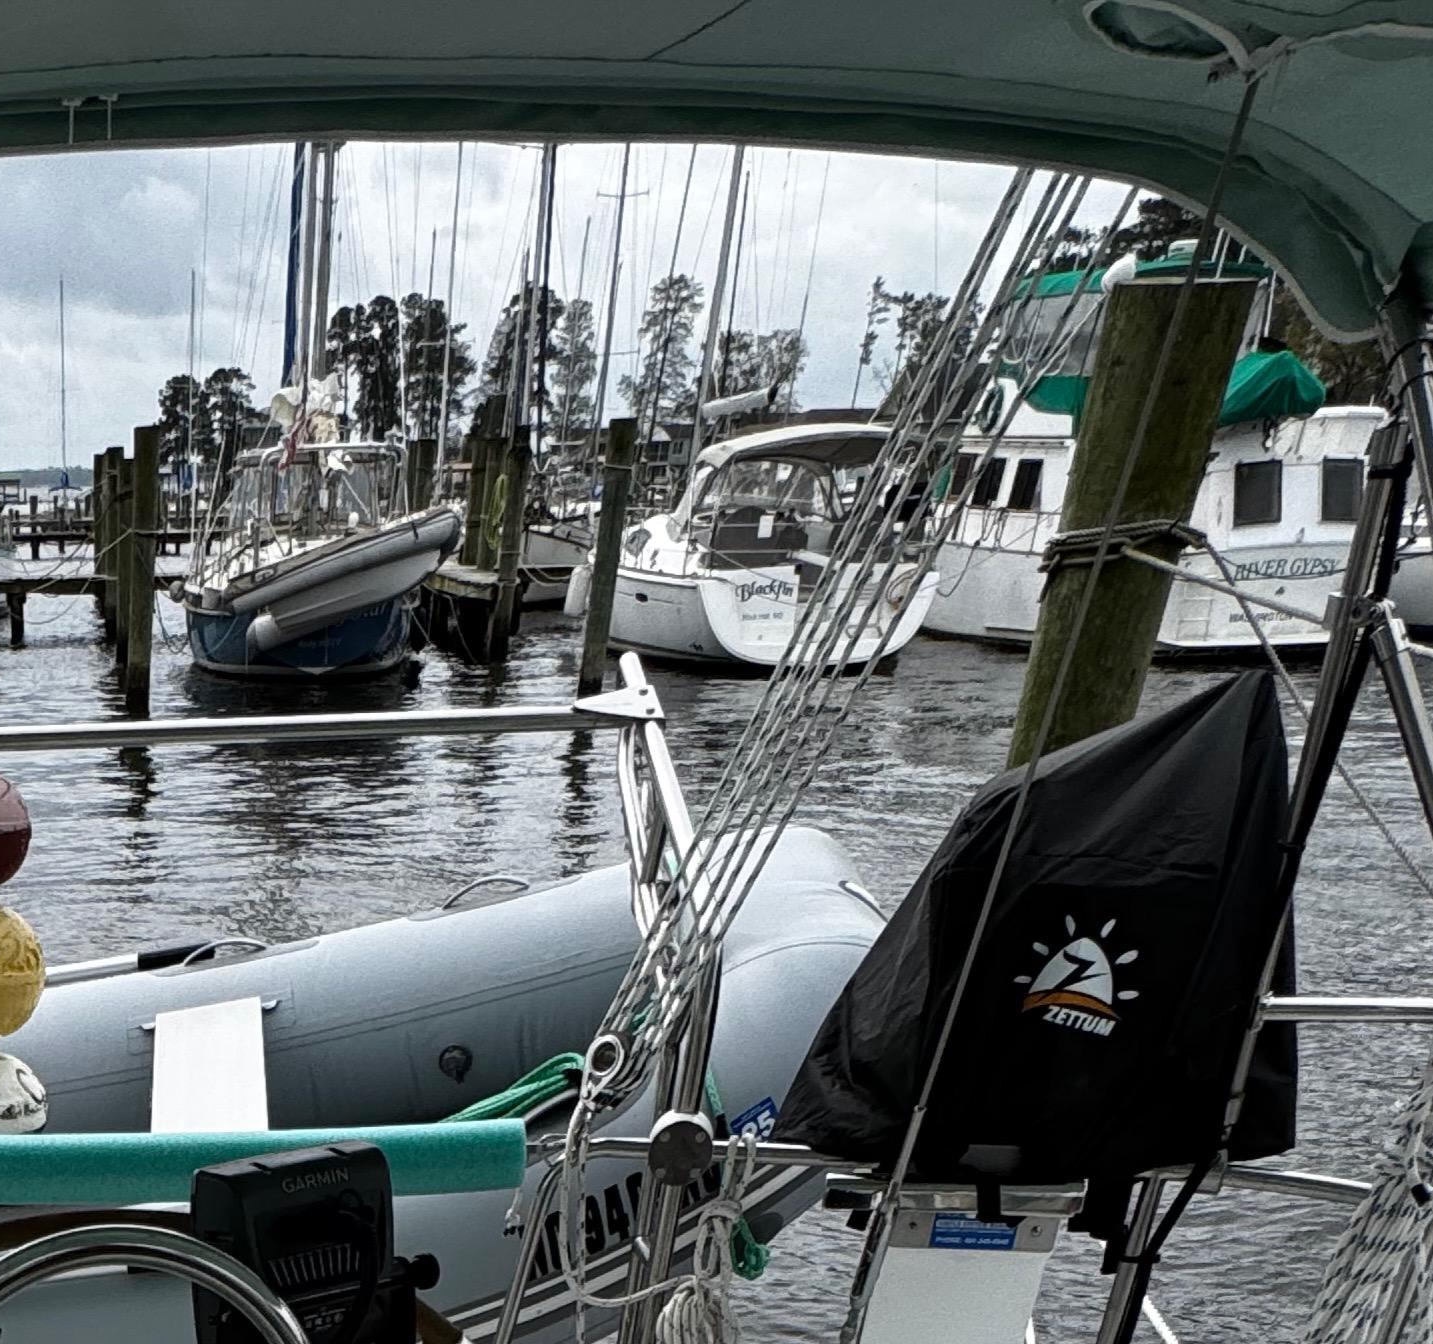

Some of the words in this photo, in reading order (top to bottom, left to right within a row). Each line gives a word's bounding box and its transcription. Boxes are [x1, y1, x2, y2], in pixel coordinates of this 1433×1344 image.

[1234, 558, 1288, 581] RIVER
[1290, 557, 1340, 576] GYPSY
[735, 579, 794, 602] Blackfin
[1042, 1004, 1117, 1036] ZETTUM
[281, 1167, 350, 1194] GARMIN
